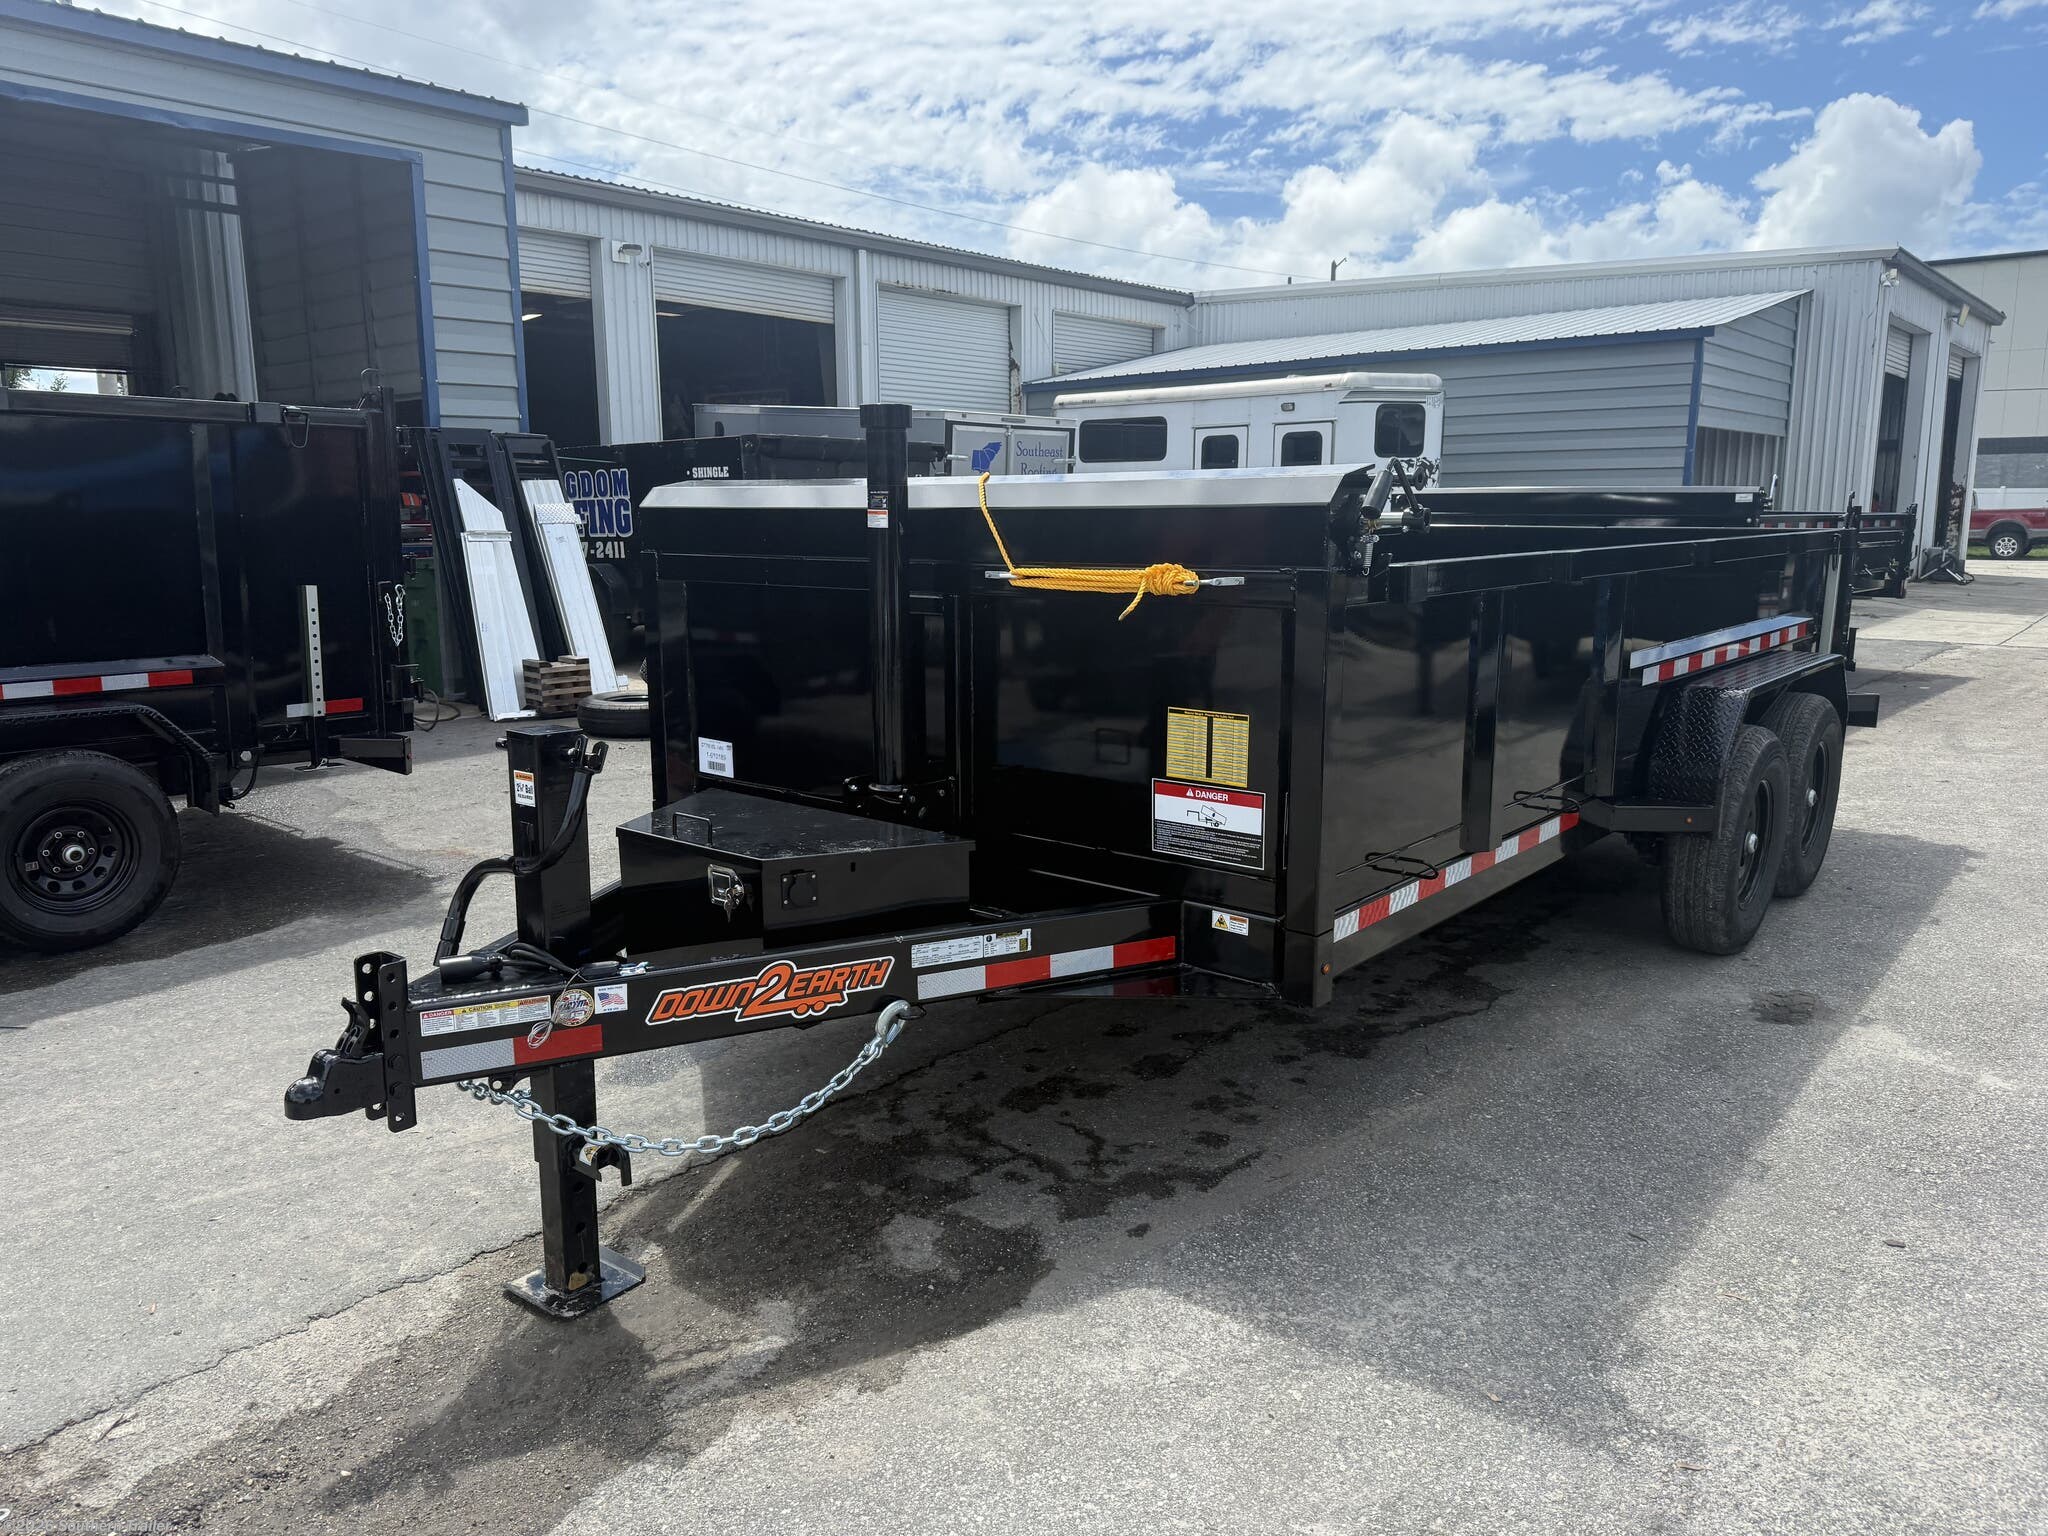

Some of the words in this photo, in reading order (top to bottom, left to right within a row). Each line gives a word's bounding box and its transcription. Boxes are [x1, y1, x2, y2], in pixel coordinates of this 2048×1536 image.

[1016, 441, 1064, 458] Southeast
[692, 466, 730, 479] SHINGLE
[1195, 789, 1229, 802] DANGER
[429, 1010, 452, 1018] DANGER
[468, 1005, 493, 1013] CAUTION
